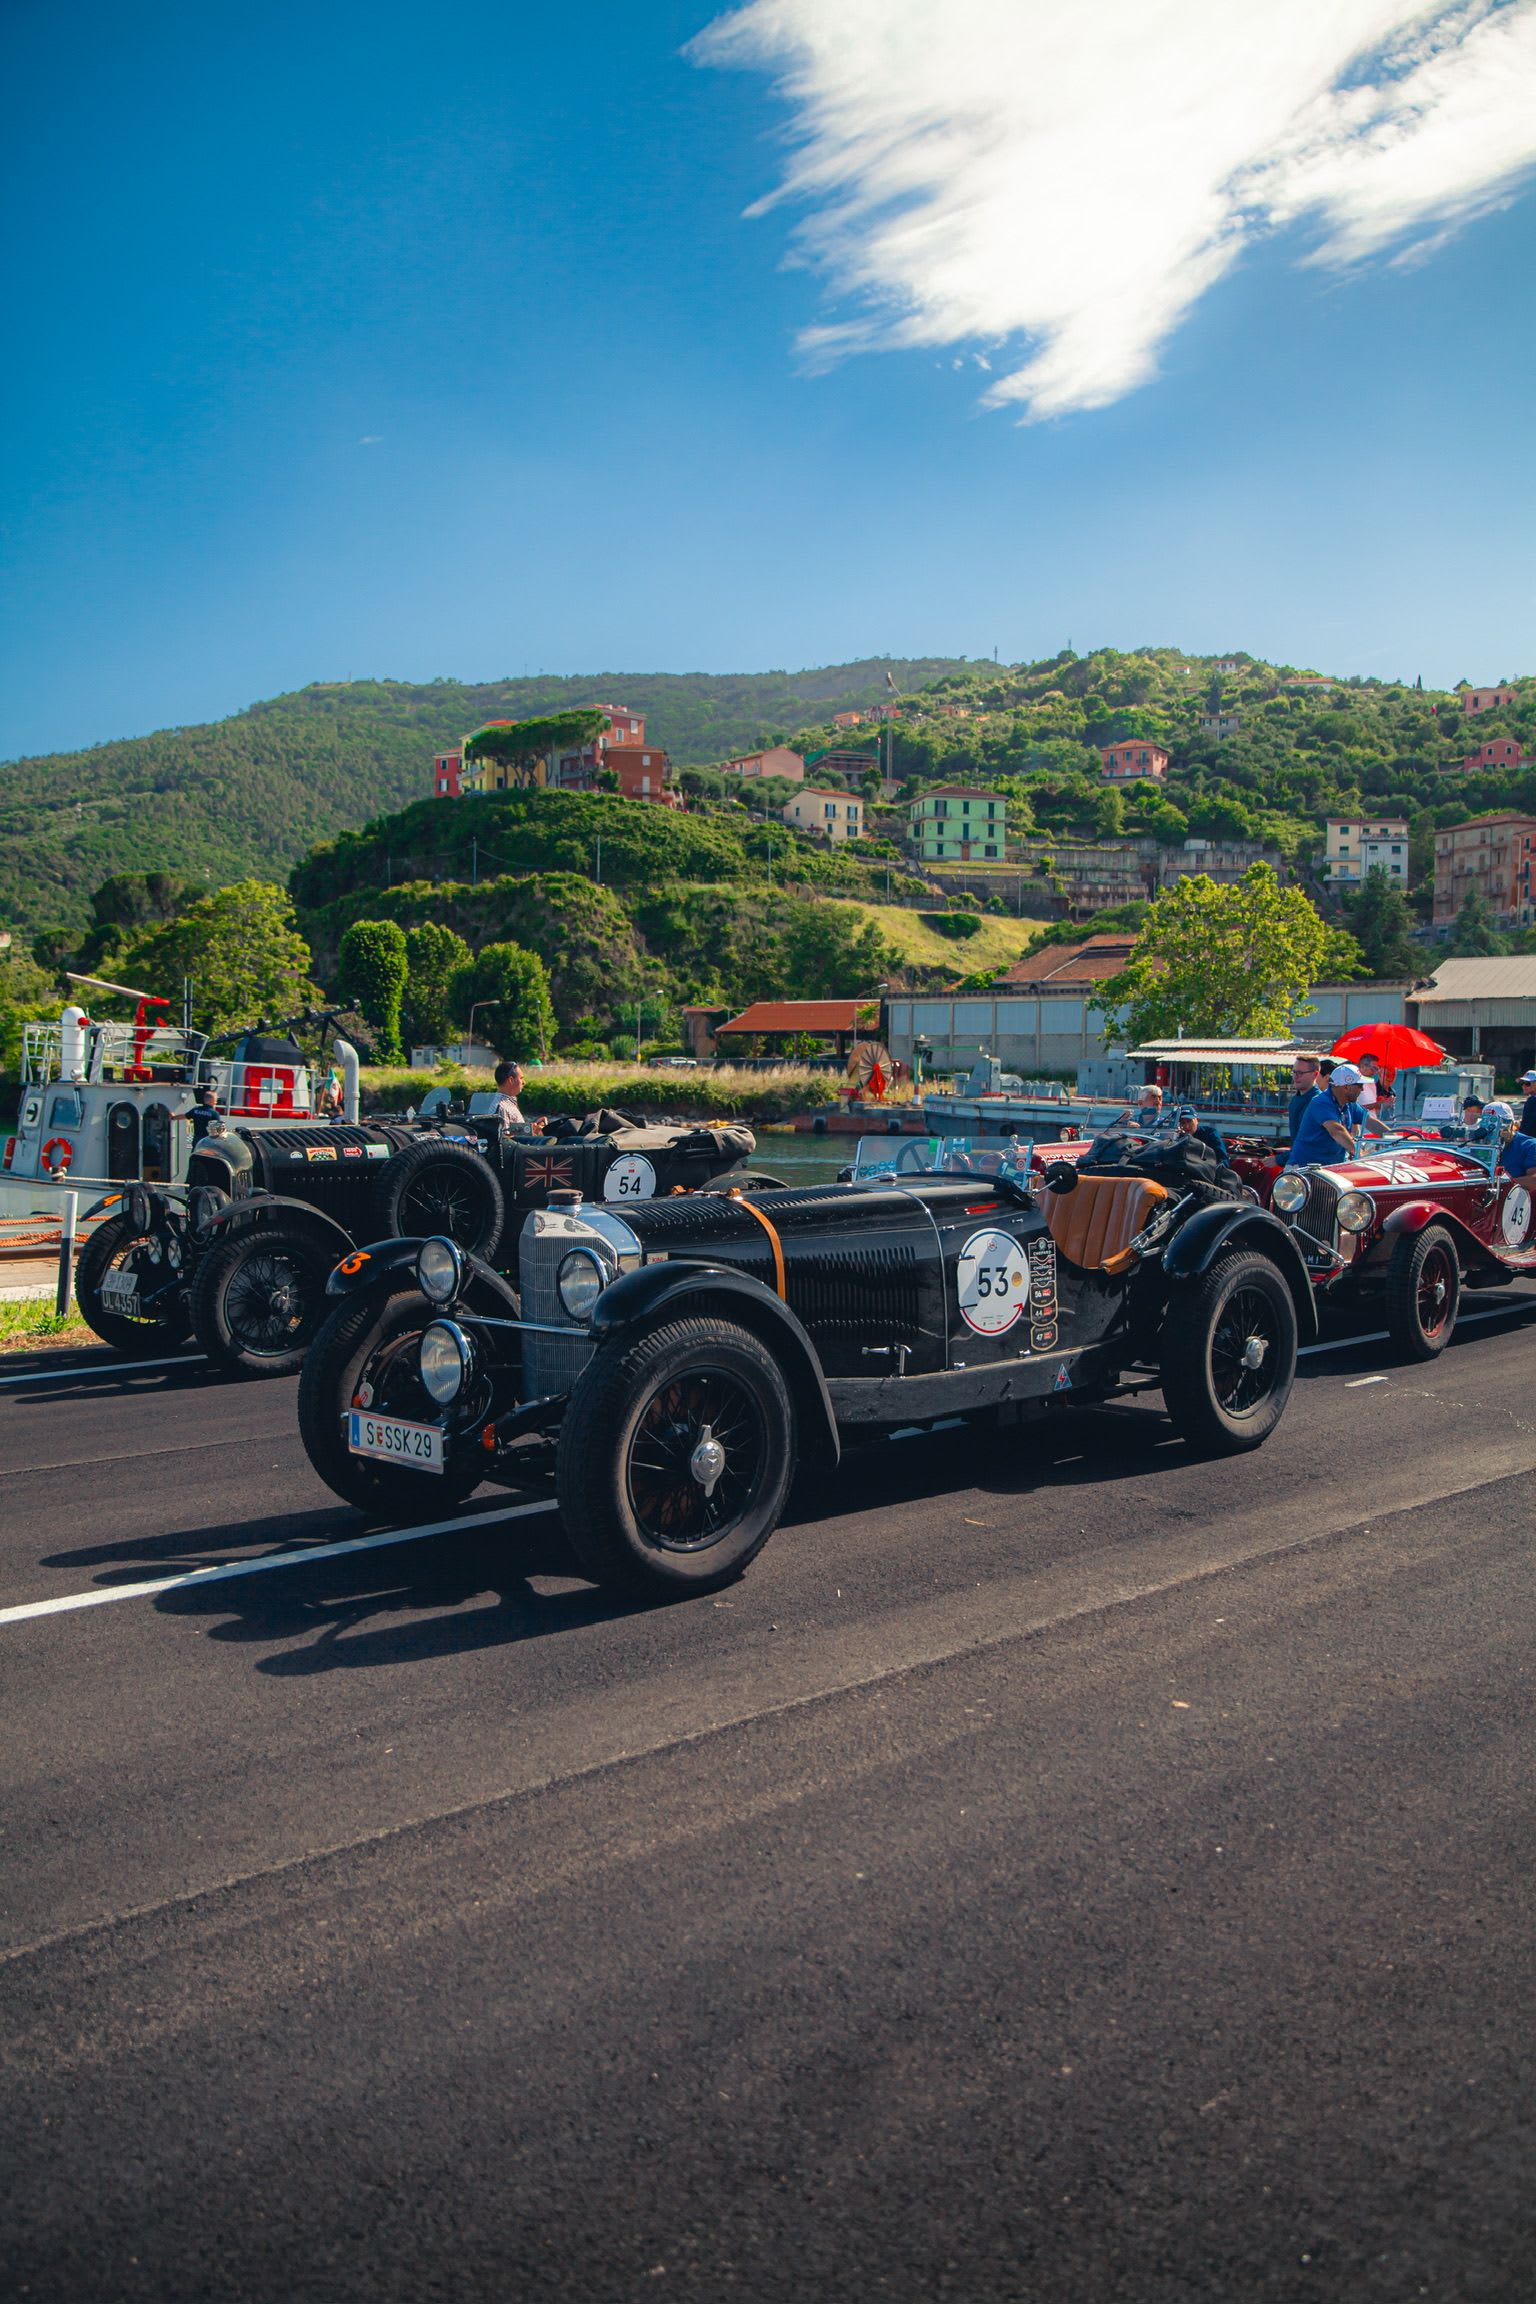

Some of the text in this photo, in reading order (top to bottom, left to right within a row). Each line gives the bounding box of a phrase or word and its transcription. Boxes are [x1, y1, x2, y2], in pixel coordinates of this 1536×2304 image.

[619, 1176, 641, 1195] 54
[1511, 1207, 1524, 1226] 43
[978, 1267, 1008, 1297] 53
[366, 1422, 432, 1458] S SSK 29
